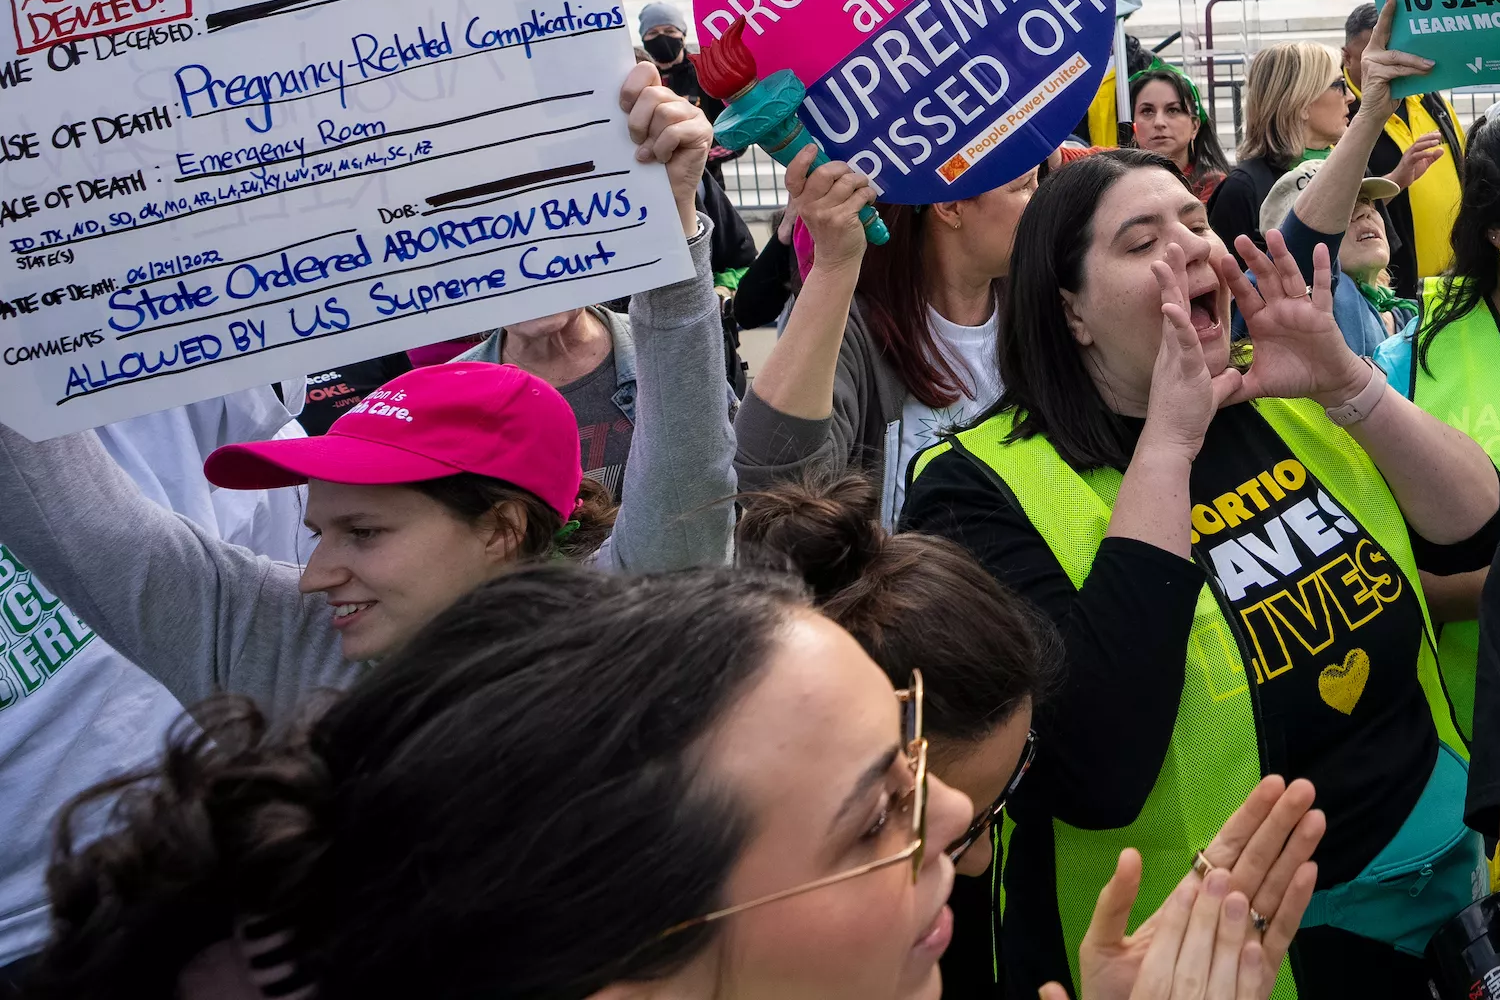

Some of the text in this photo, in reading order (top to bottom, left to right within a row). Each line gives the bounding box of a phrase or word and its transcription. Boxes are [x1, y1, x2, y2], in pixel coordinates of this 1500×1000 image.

[47, 42, 89, 72] OF
[1409, 14, 1473, 35] LEARN
[51, 121, 87, 150] OF
[465, 1, 624, 59] Complications
[965, 56, 1087, 160] People Power United
[44, 185, 74, 210] OF
[176, 137, 306, 179] Emergency
[317, 119, 387, 144] Room
[849, 54, 1013, 198] PISSED
[377, 203, 420, 225] DOB:
[0, 292, 40, 320] ATE
[41, 288, 65, 307] OF
[127, 249, 224, 284] 06/24/2022
[3, 188, 649, 366] COMMENTS State Ordered ABORTION BANS,
[64, 240, 617, 397] ALLOWED BY US Supreme Court
[306, 383, 356, 404] OKE.
[368, 401, 413, 422] Care.
[1191, 458, 1307, 545] ORTIO
[1209, 488, 1358, 602] AVES
